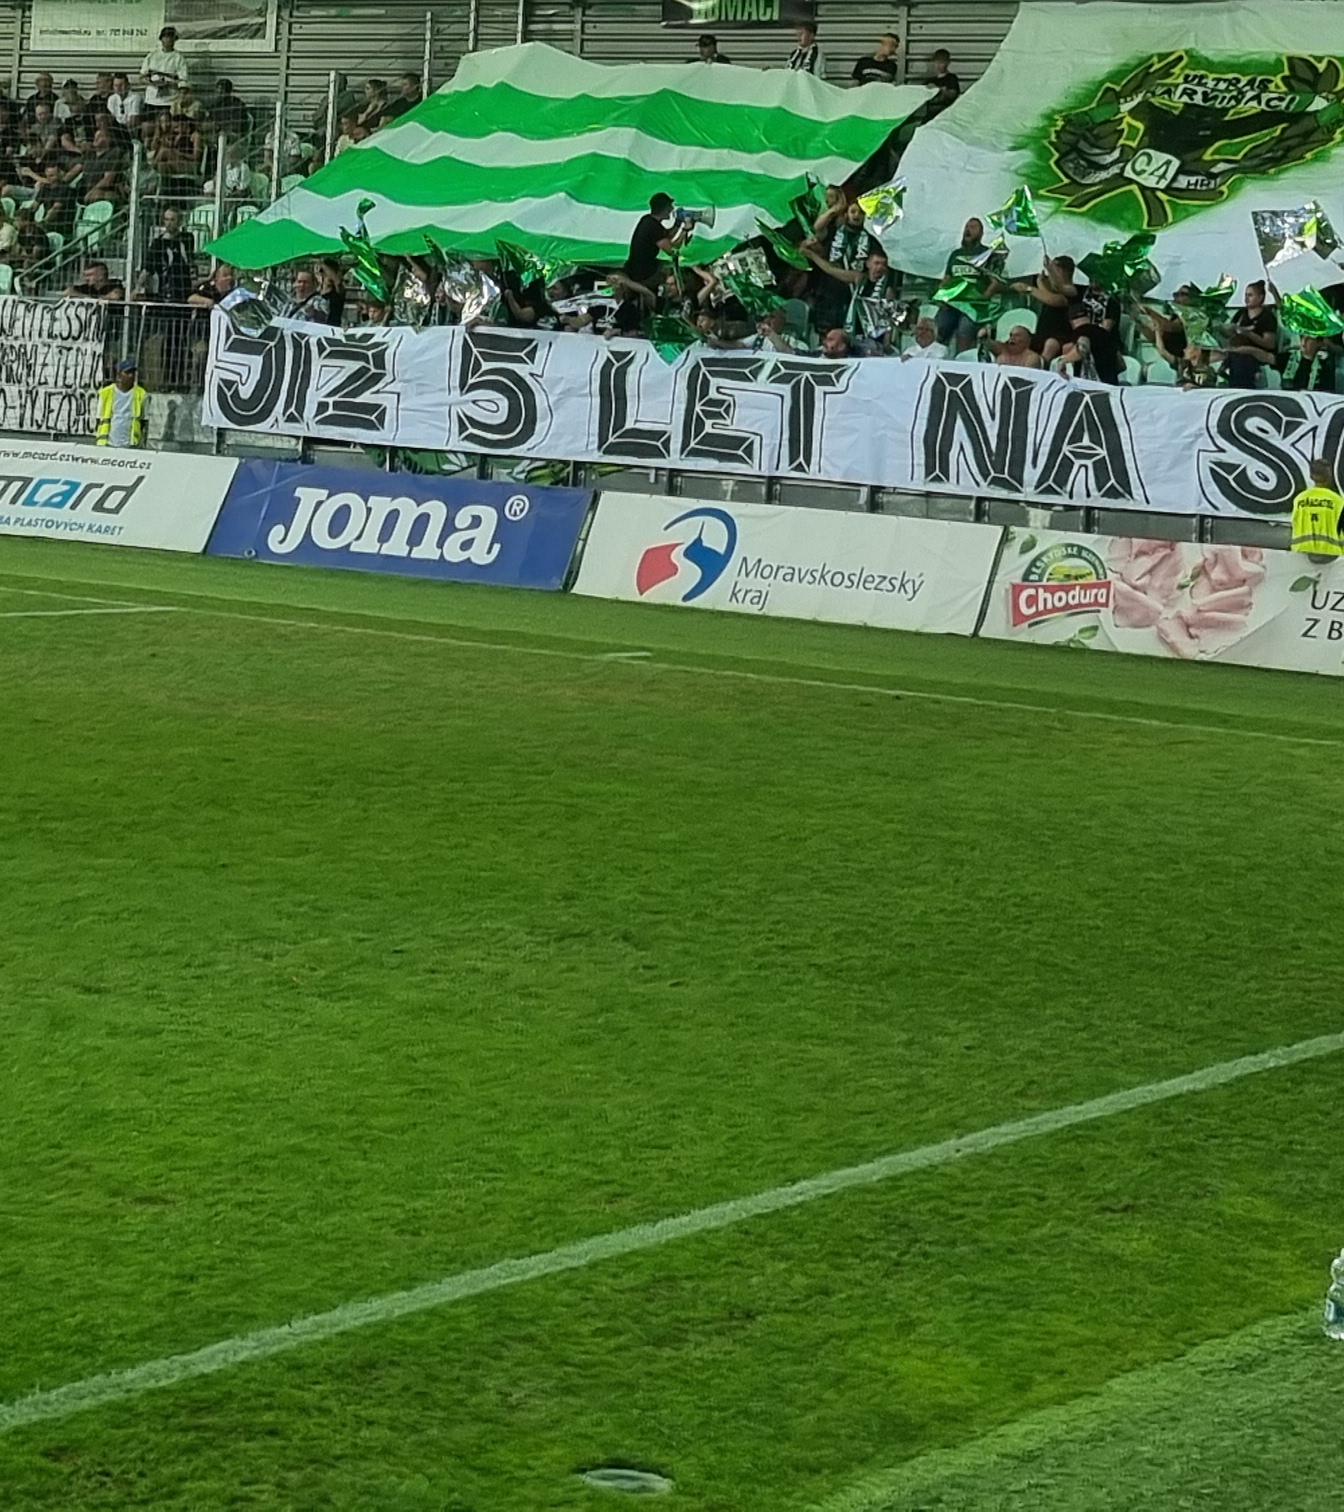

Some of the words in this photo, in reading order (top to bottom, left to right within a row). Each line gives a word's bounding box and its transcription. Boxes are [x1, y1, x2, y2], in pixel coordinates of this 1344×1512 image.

[216, 320, 389, 432] JIŽ
[458, 332, 540, 450] 5
[597, 349, 855, 473] LET
[923, 371, 1135, 501] NA
[13, 515, 85, 532] PLASTOVÝCH
[87, 522, 125, 537] KARET
[737, 555, 925, 603] Moravskoslezský
[729, 581, 773, 612] kraj
[1018, 585, 1107, 616] Chodura
[1301, 617, 1321, 639] Z
